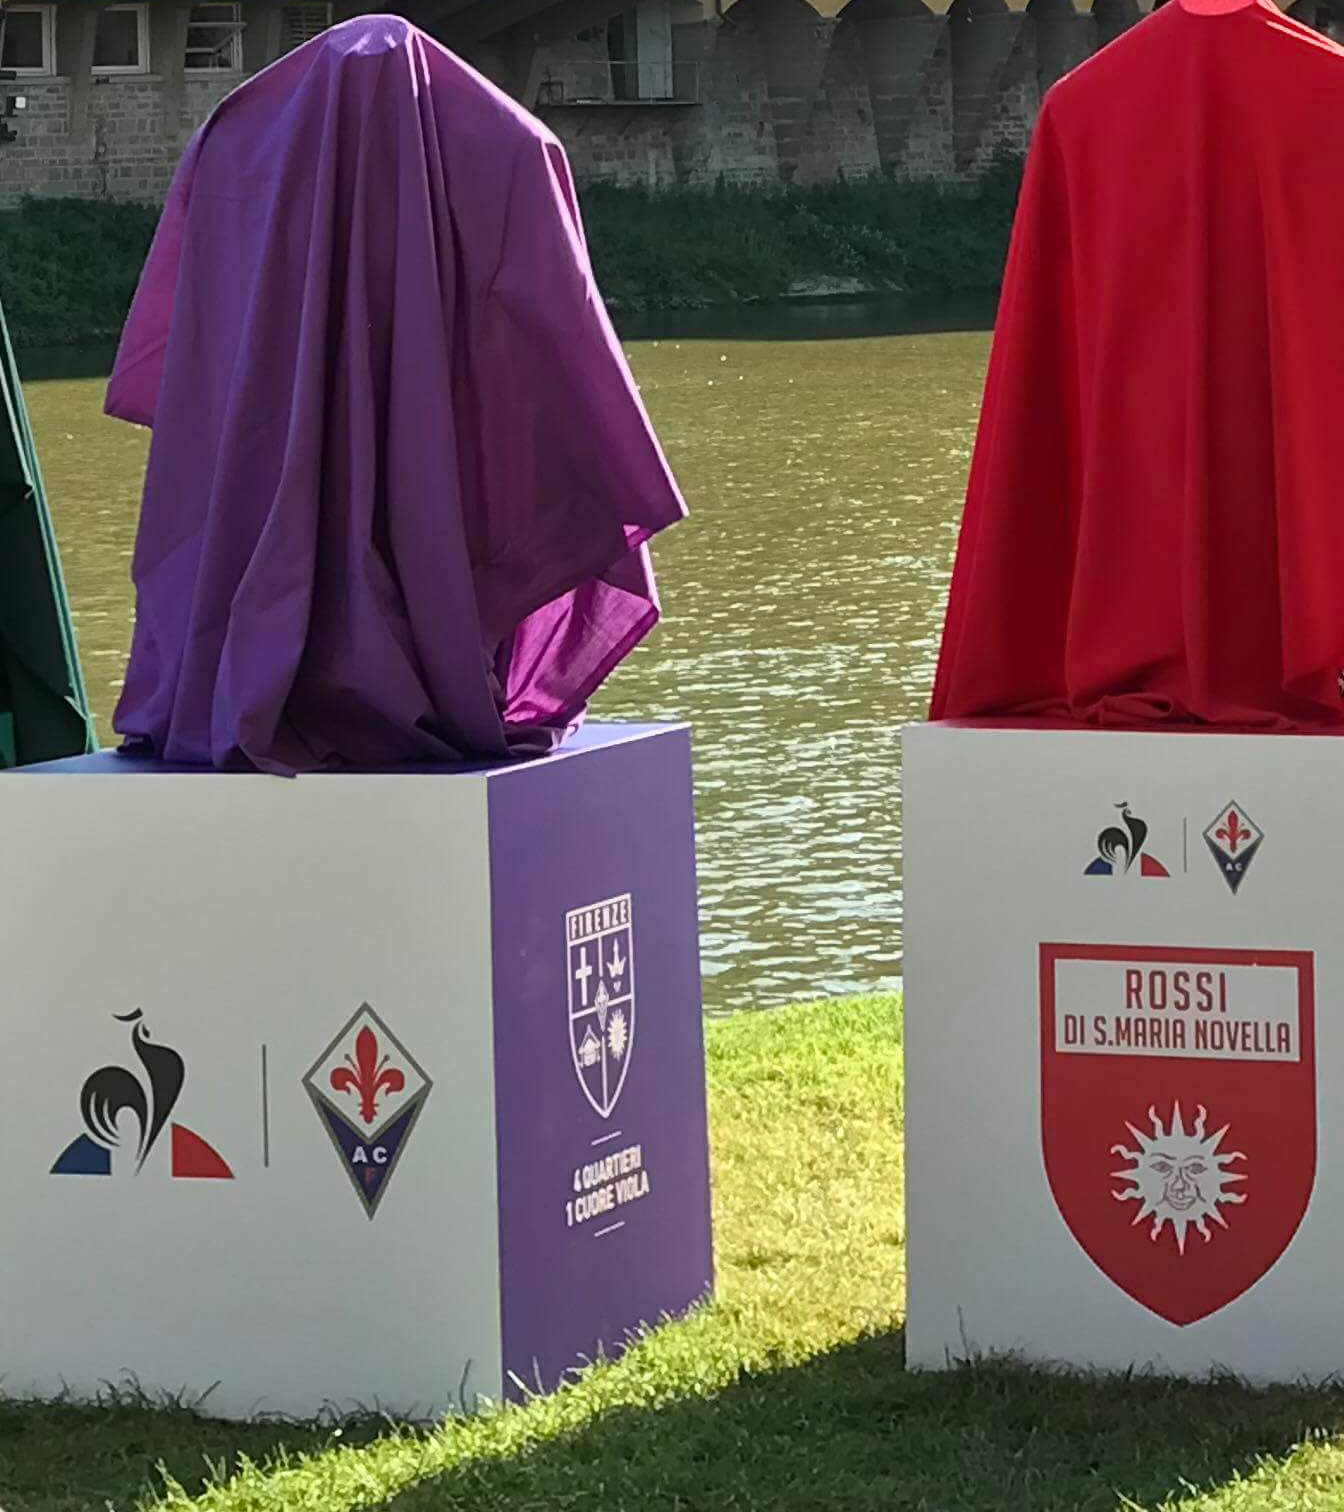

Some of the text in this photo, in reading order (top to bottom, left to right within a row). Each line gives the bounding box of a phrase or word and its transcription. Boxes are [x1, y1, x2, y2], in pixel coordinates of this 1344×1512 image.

[570, 899, 627, 940] FIRENZE
[1125, 969, 1227, 1013] ROSSI
[1064, 1014, 1291, 1053] DI S.MARIA NOVELLA
[582, 1144, 642, 1189] QUARTIERI
[566, 1170, 650, 1227] 1 CUORE VIOLA
